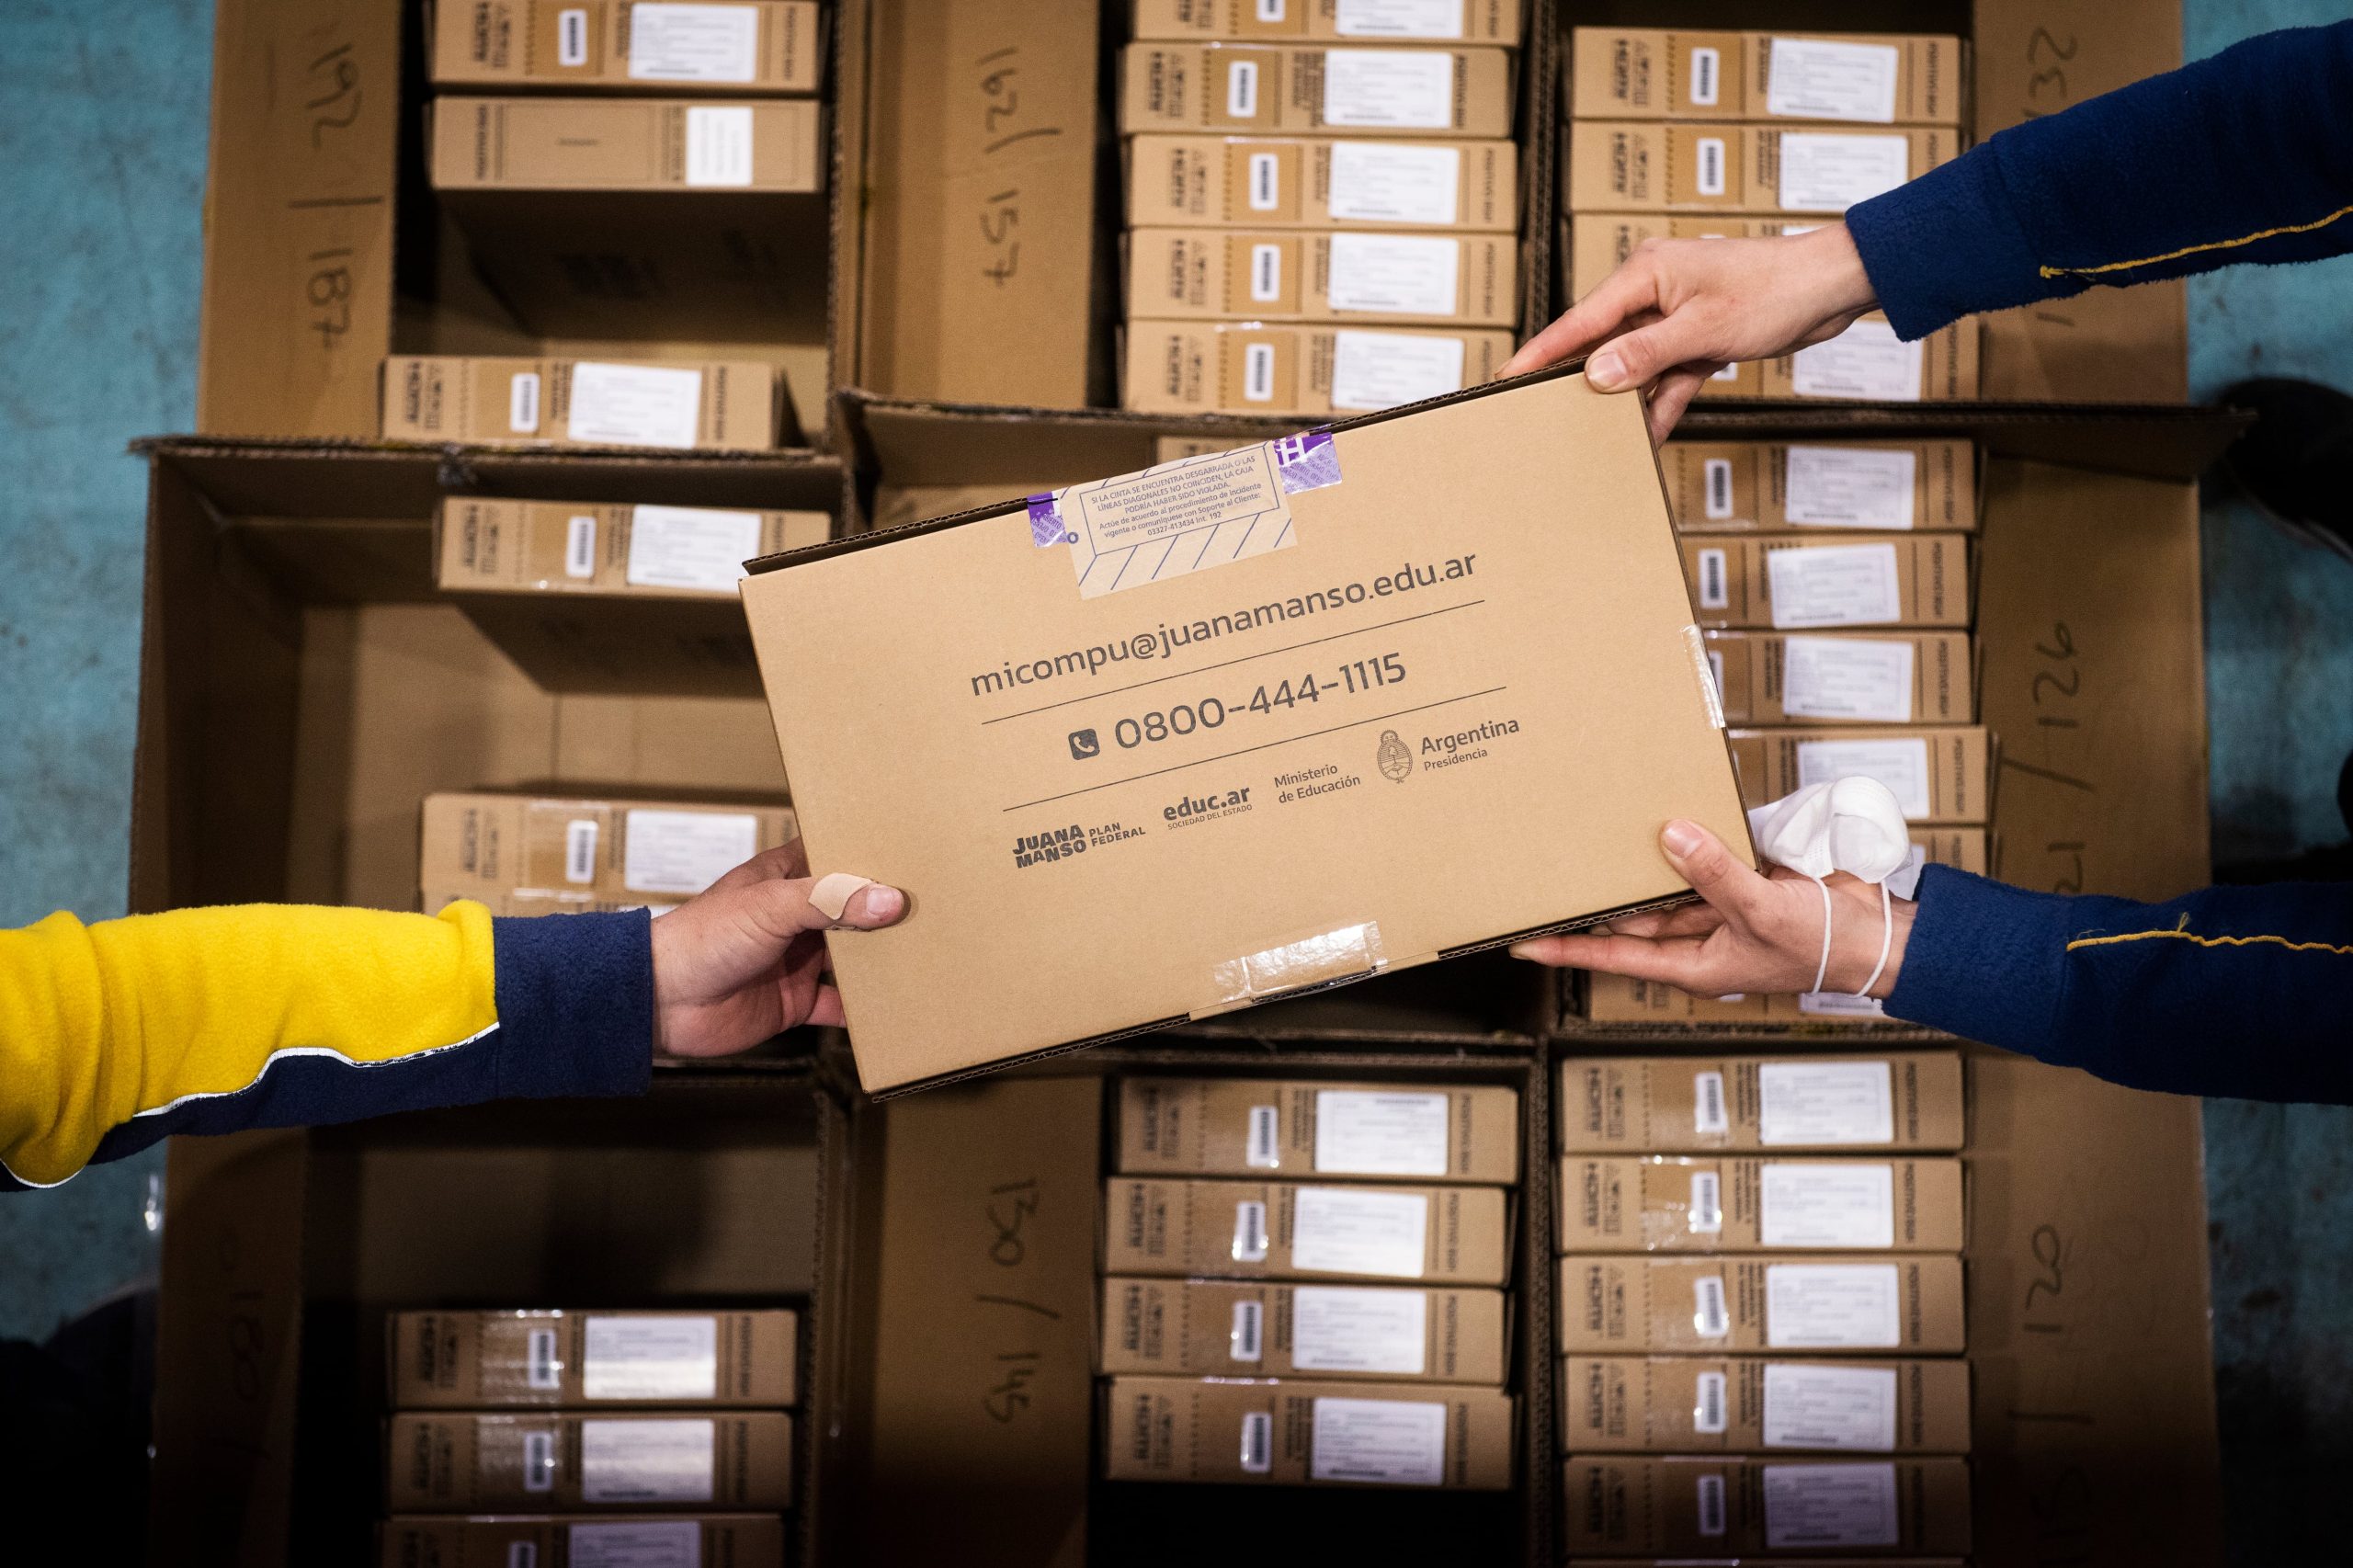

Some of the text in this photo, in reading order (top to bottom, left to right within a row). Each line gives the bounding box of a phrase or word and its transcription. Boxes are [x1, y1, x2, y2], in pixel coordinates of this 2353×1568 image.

[975, 46, 1020, 133] 162
[980, 189, 1020, 288] 157
[307, 248, 355, 349] 187
[1097, 498, 1122, 511] LÍNEAS
[1123, 488, 1168, 504] DIAGONALES
[1183, 474, 1223, 490] COINCIDEN,
[1235, 466, 1253, 475] CAJA
[1109, 488, 1131, 499] CINTA
[1142, 475, 1184, 490] ENCUENTRA
[1186, 462, 1233, 479] DESGARRADA
[1242, 456, 1255, 464] LAS
[1124, 500, 1152, 513] PODRÍA
[1154, 495, 1176, 506] HABER
[1178, 490, 1195, 499] SIDO
[1131, 509, 1158, 521] acuerdo
[1168, 494, 1218, 513] procedimiento
[1229, 483, 1261, 495] incidente
[1210, 511, 1222, 519] 192
[1104, 526, 1130, 539] vigente
[1198, 501, 1225, 515] Soporte
[971, 551, 1478, 696] micompu@juanamanso.edu.ar
[2031, 621, 2079, 728] 126
[1115, 653, 1406, 749] 0800-444-1115
[1422, 720, 1520, 755] Argentina
[1274, 765, 1338, 788] Ministerio
[1424, 748, 1488, 771] Presidencia
[1164, 787, 1250, 821] educ.ar
[1279, 776, 1360, 803] de Educación
[1088, 822, 1121, 837] PLAN
[1167, 804, 1252, 830] SOCIEDAD DEL ESTADO
[1013, 824, 1086, 855] JUANA
[1091, 826, 1146, 846] FEDERAL
[1016, 839, 1086, 869] MANSO
[2022, 1223, 2063, 1333] 120
